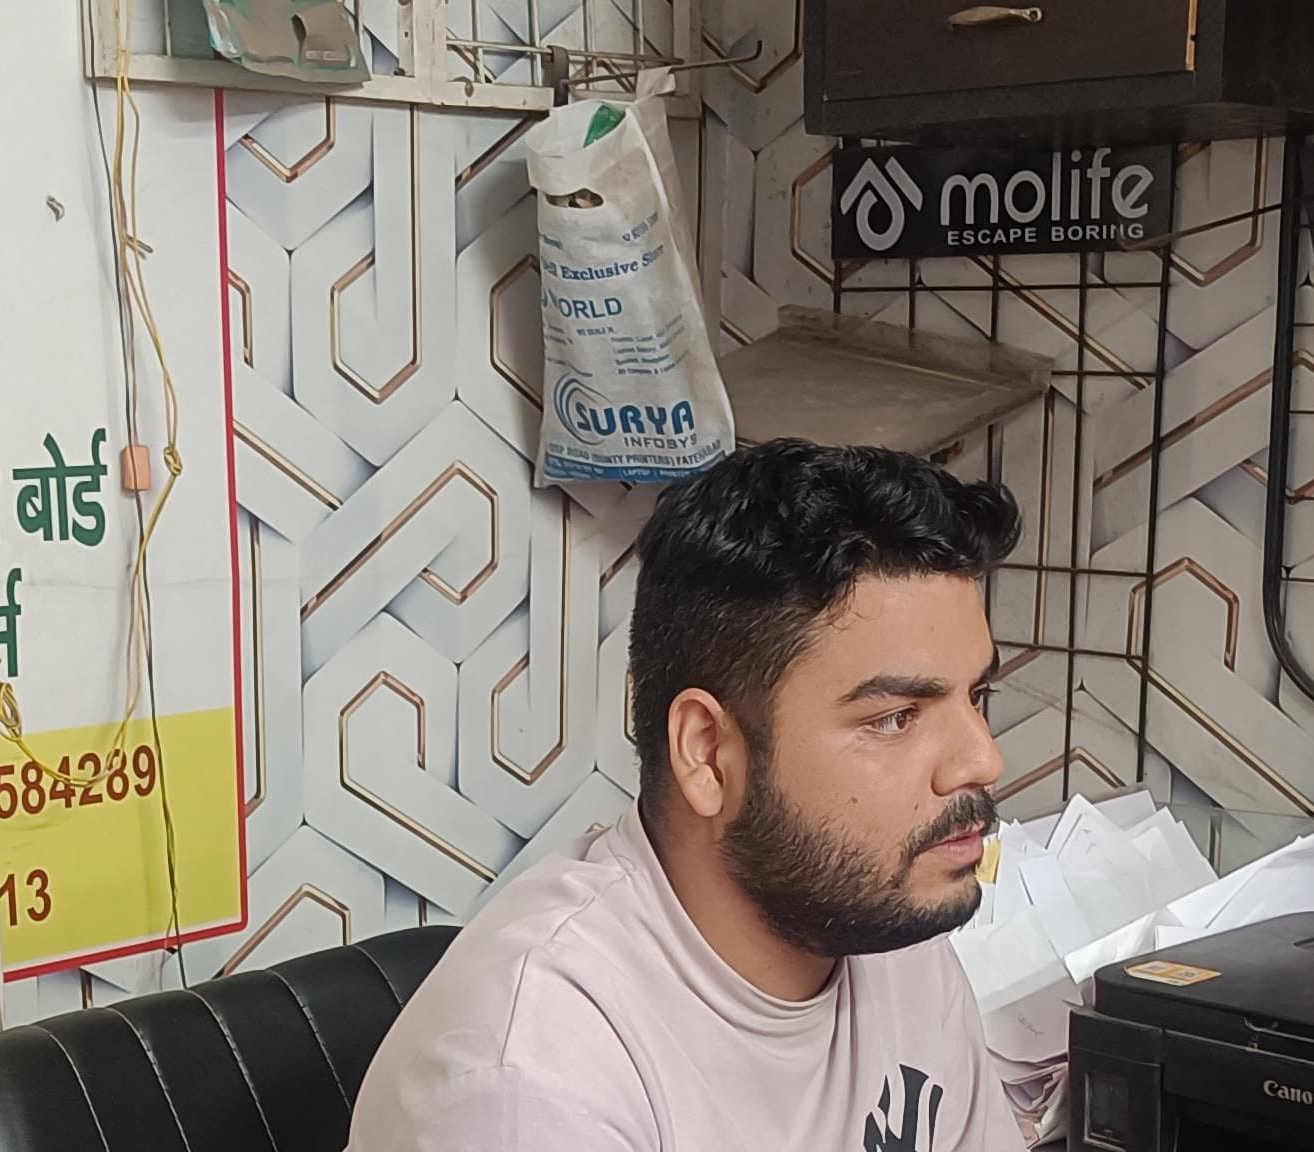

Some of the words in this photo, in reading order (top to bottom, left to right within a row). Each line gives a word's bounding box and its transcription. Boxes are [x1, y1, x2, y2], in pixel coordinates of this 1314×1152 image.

[940, 148, 1154, 226] molife
[947, 227, 1037, 246] ESCAPE
[1051, 223, 1144, 242] BORING
[560, 259, 640, 281] Exclusive
[575, 401, 696, 436] SURYA
[13, 428, 108, 548] बोर्ड
